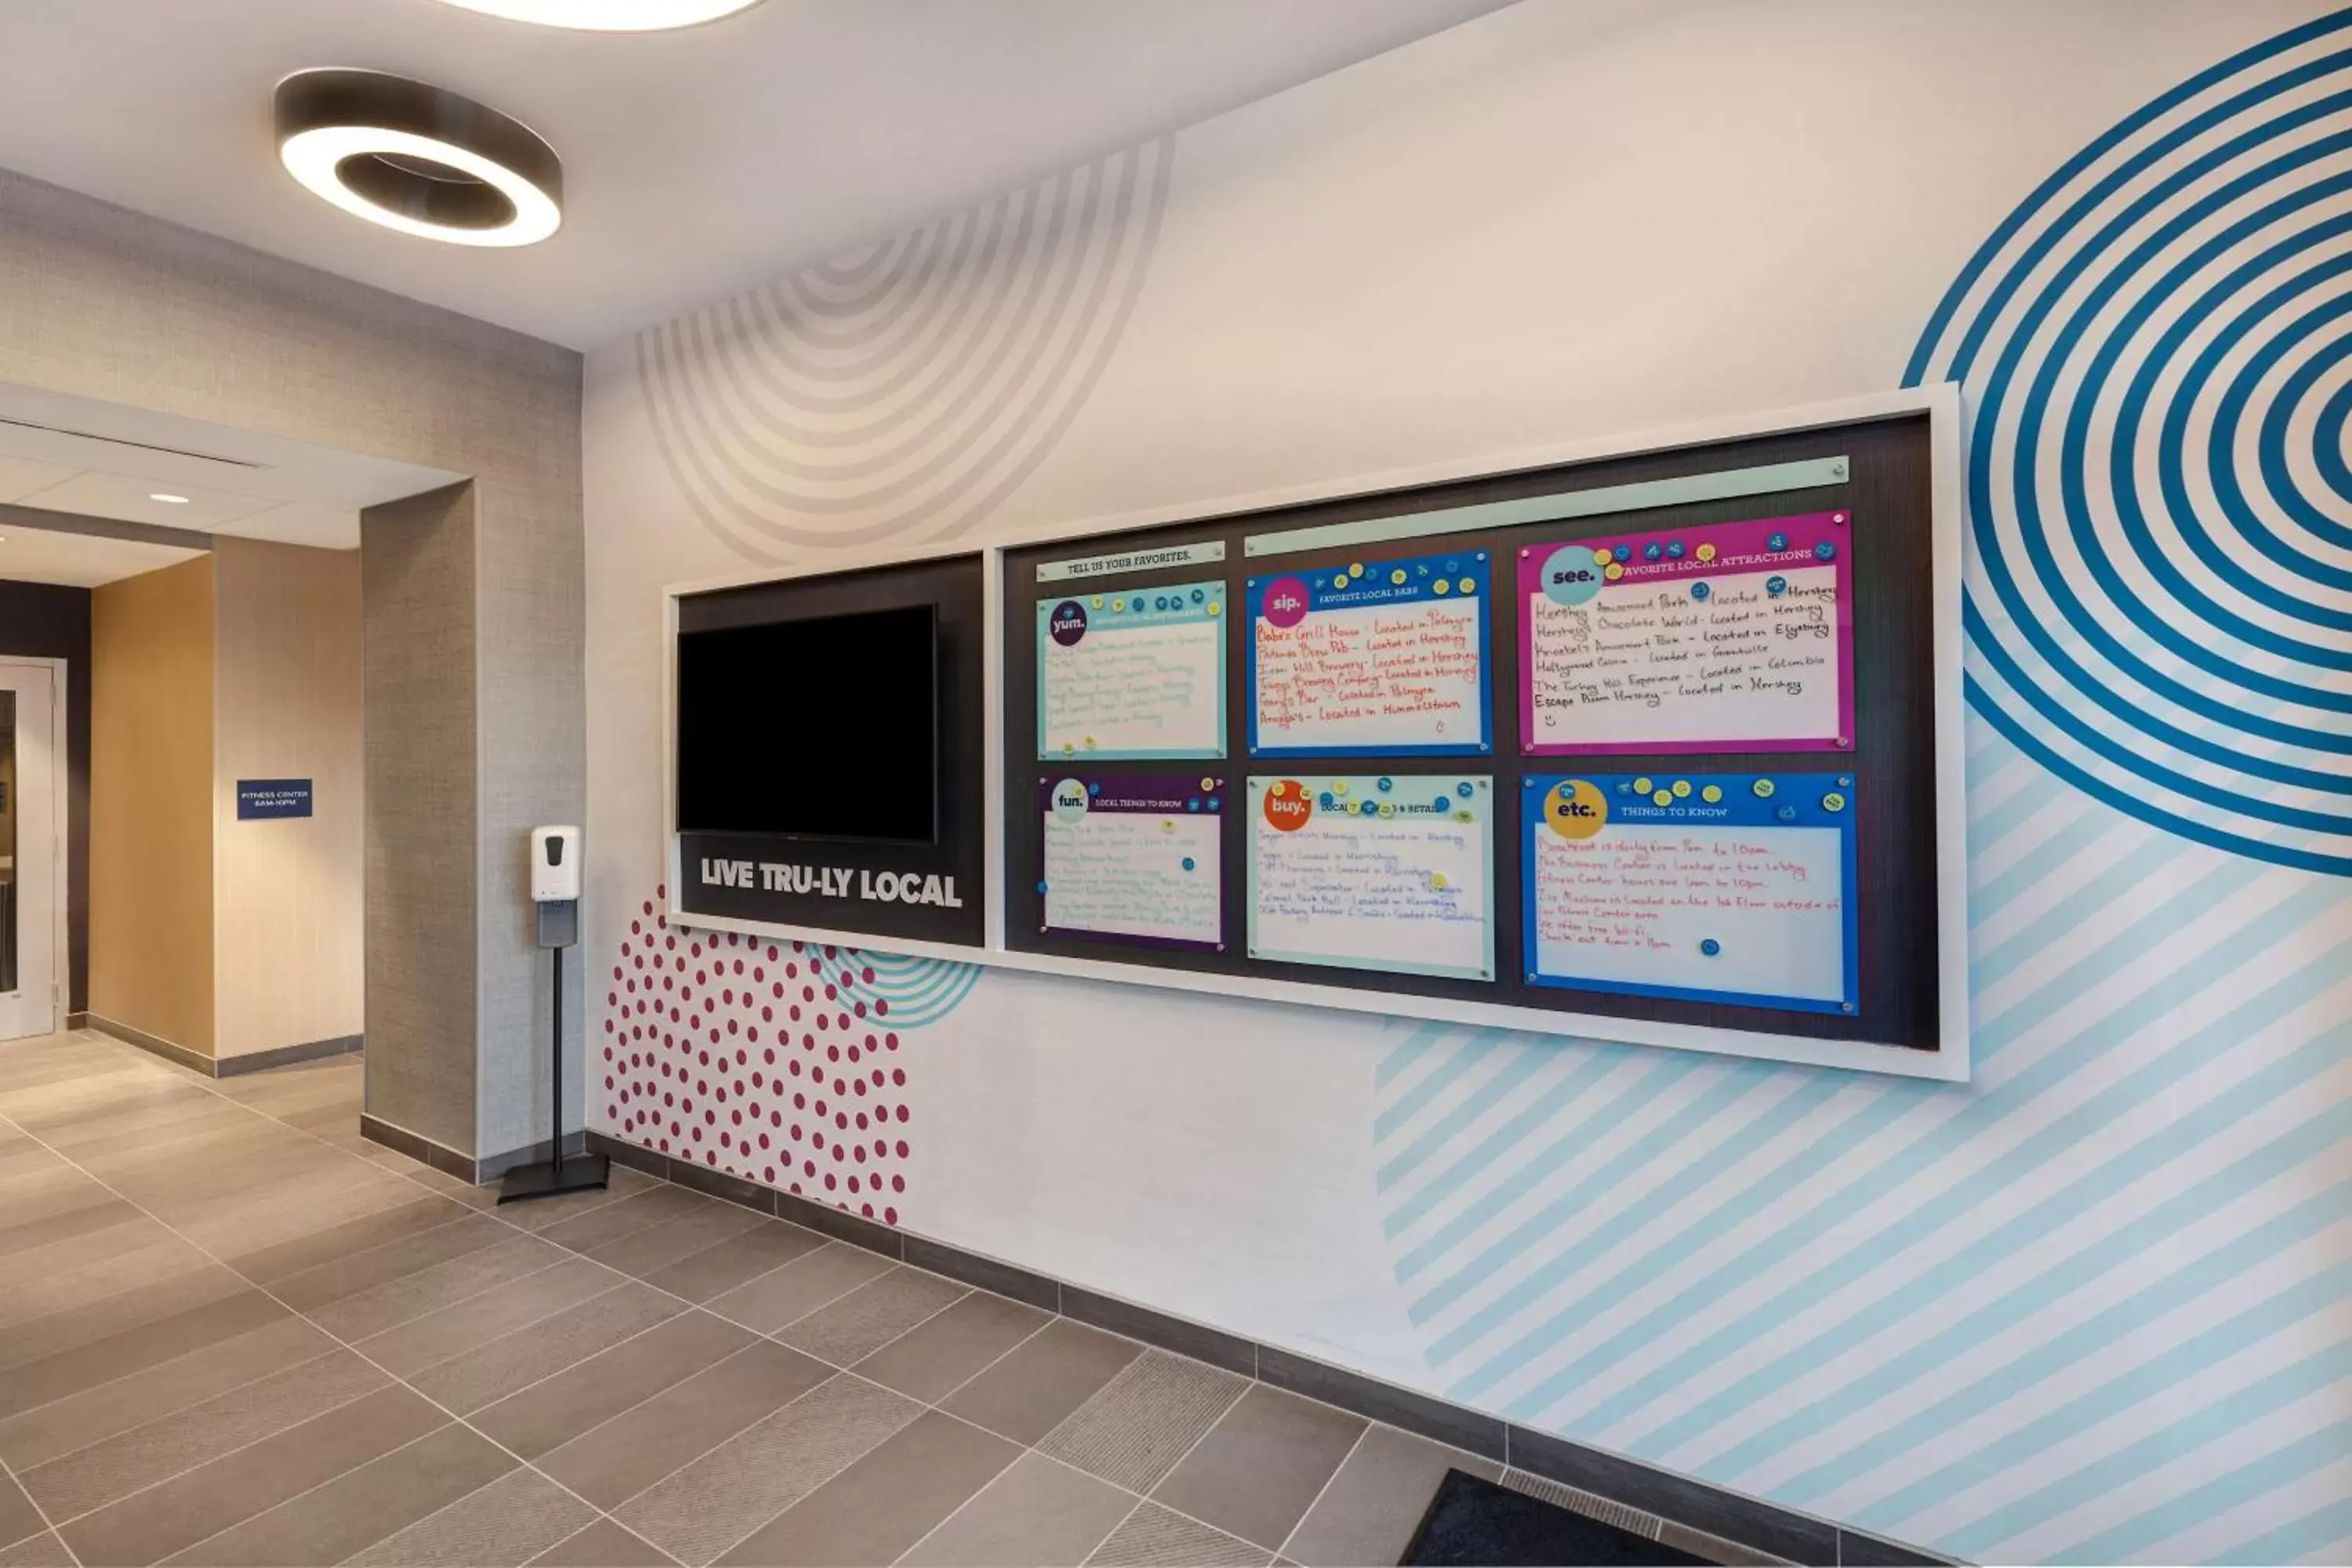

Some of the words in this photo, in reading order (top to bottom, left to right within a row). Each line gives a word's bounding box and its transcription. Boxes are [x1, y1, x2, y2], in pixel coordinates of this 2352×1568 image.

[1068, 564, 1090, 574] TELL
[1091, 561, 1103, 572] US
[1105, 557, 1131, 570] YOUR
[1623, 563, 1676, 576] AVORITE
[1678, 560, 1719, 571] LOCAL
[1722, 549, 1812, 567] ATTRACTIONS
[1553, 570, 1595, 584] see.
[1272, 593, 1301, 612] sip.
[1319, 592, 1361, 604] FAVORITE
[1363, 590, 1392, 599] LOCAL
[1053, 619, 1085, 633] yum.
[241, 791, 276, 800] FITNESS
[1058, 794, 1083, 807] fun.
[1272, 797, 1305, 816] buy.
[1558, 802, 1597, 817] etc.
[1621, 807, 1667, 817] THINGS
[1670, 807, 1686, 817] TO
[1688, 808, 1729, 817] KNOW
[701, 857, 754, 888] LIVE
[758, 861, 854, 898] TRU-LY
[859, 868, 963, 909] LOCAL
